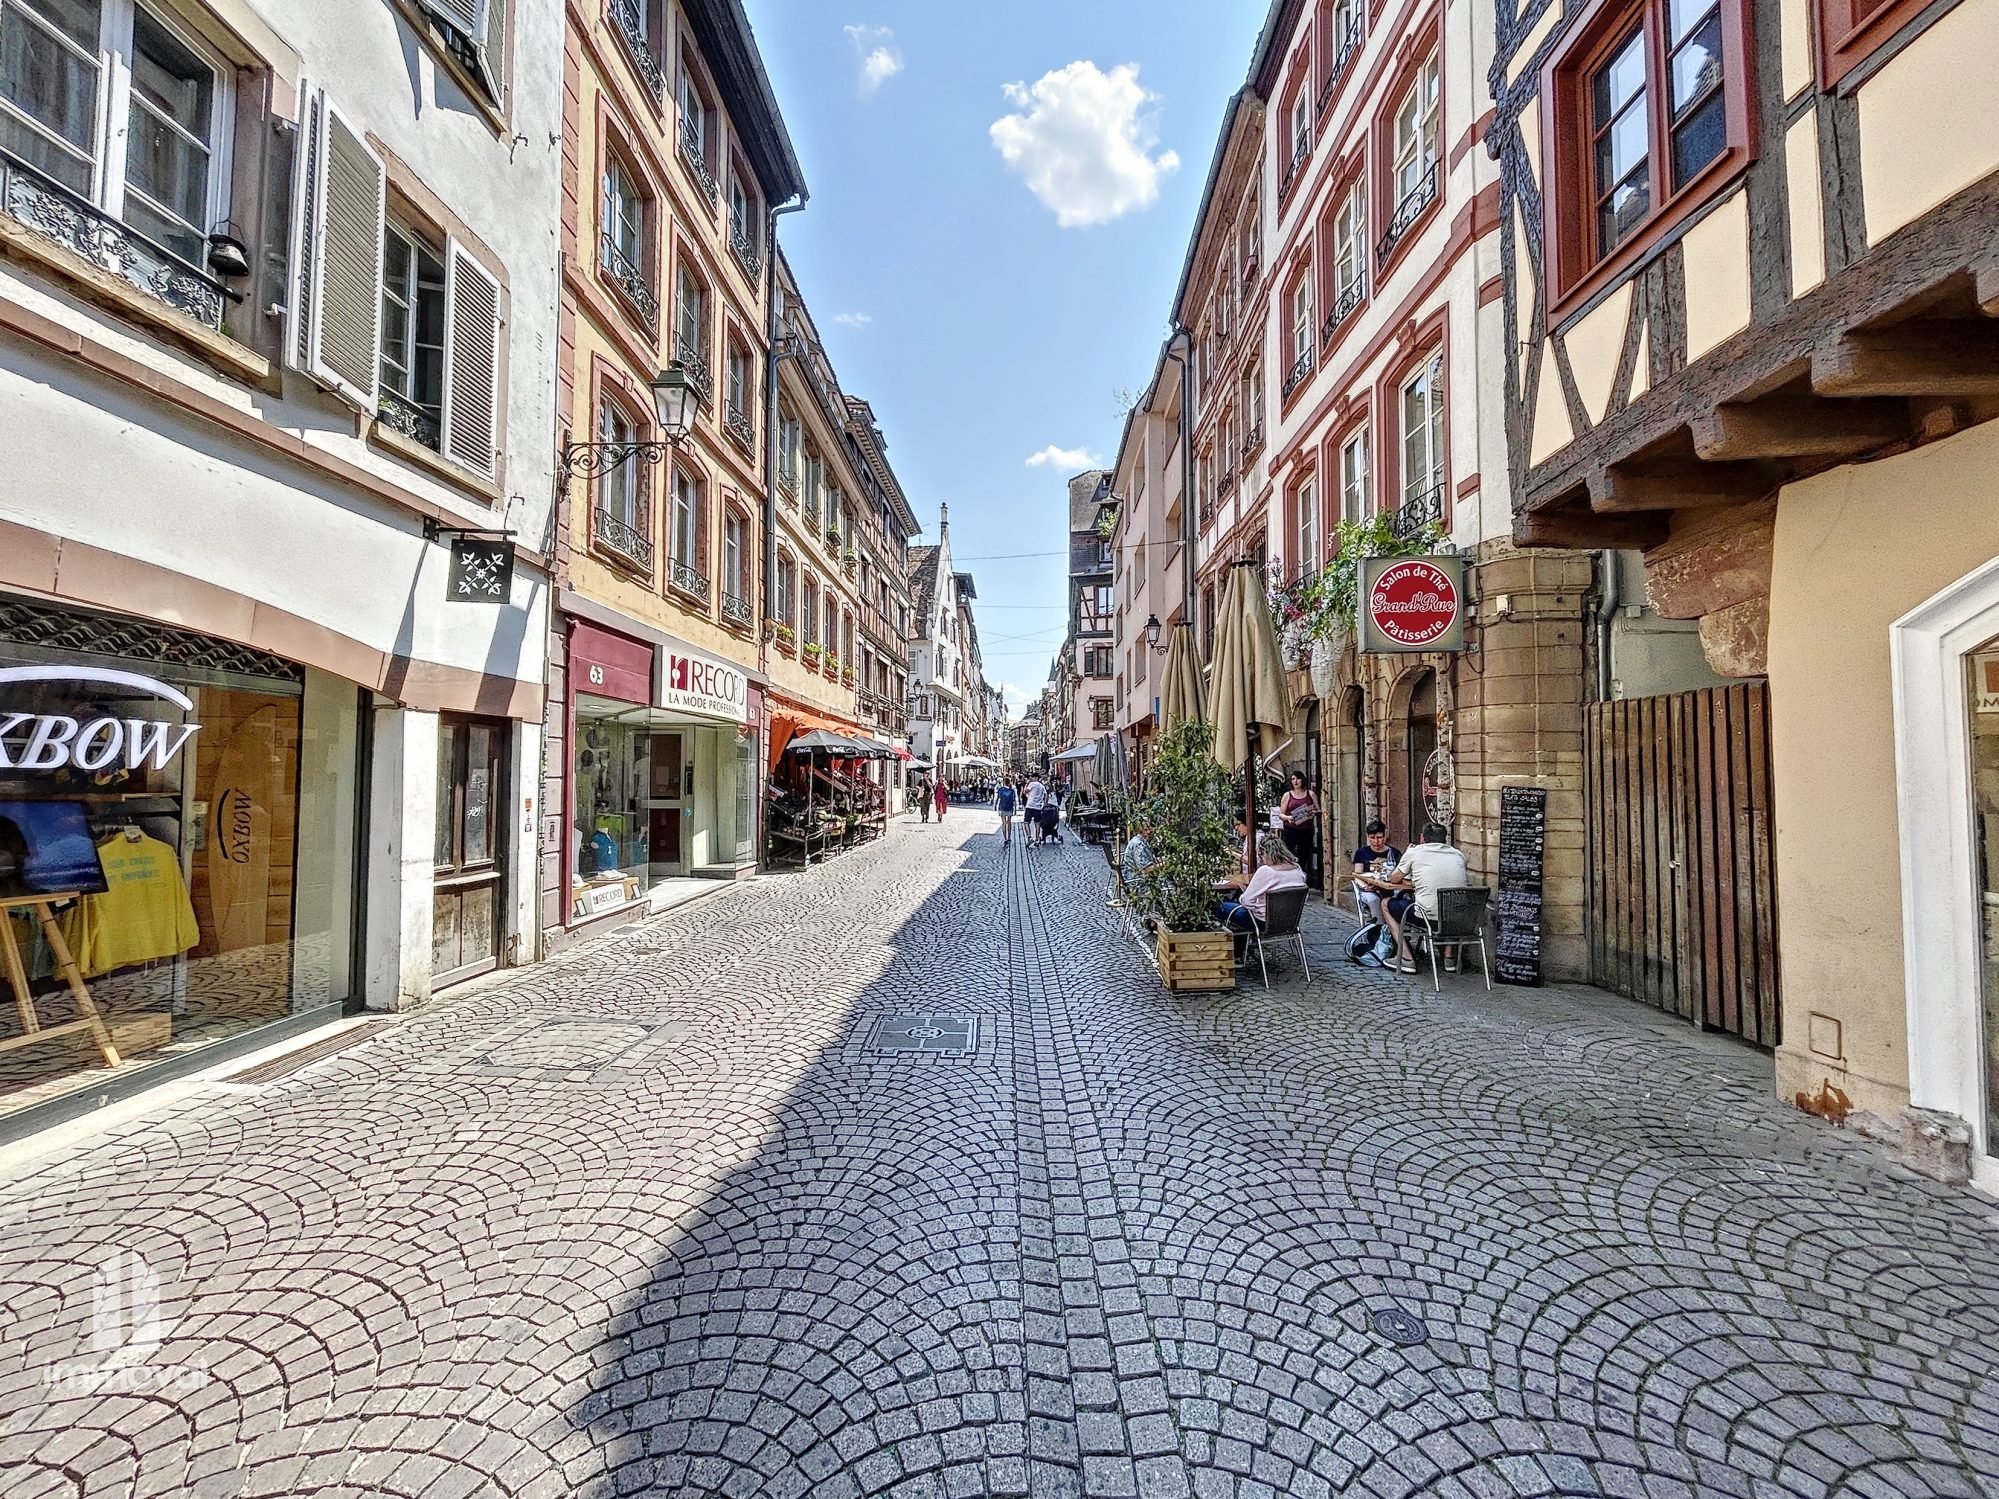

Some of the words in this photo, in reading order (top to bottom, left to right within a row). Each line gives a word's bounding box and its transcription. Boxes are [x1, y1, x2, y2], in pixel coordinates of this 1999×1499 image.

[1380, 568, 1411, 591] Salon
[1412, 565, 1428, 578] de
[1428, 570, 1449, 592] Thé
[1384, 619, 1445, 640] Pâtisserie
[589, 664, 604, 685] 63
[691, 660, 745, 706] RECORD
[668, 692, 680, 705] LA
[682, 695, 707, 709] MODE
[231, 786, 252, 864] OXBOW
[599, 888, 623, 904] RECORD
